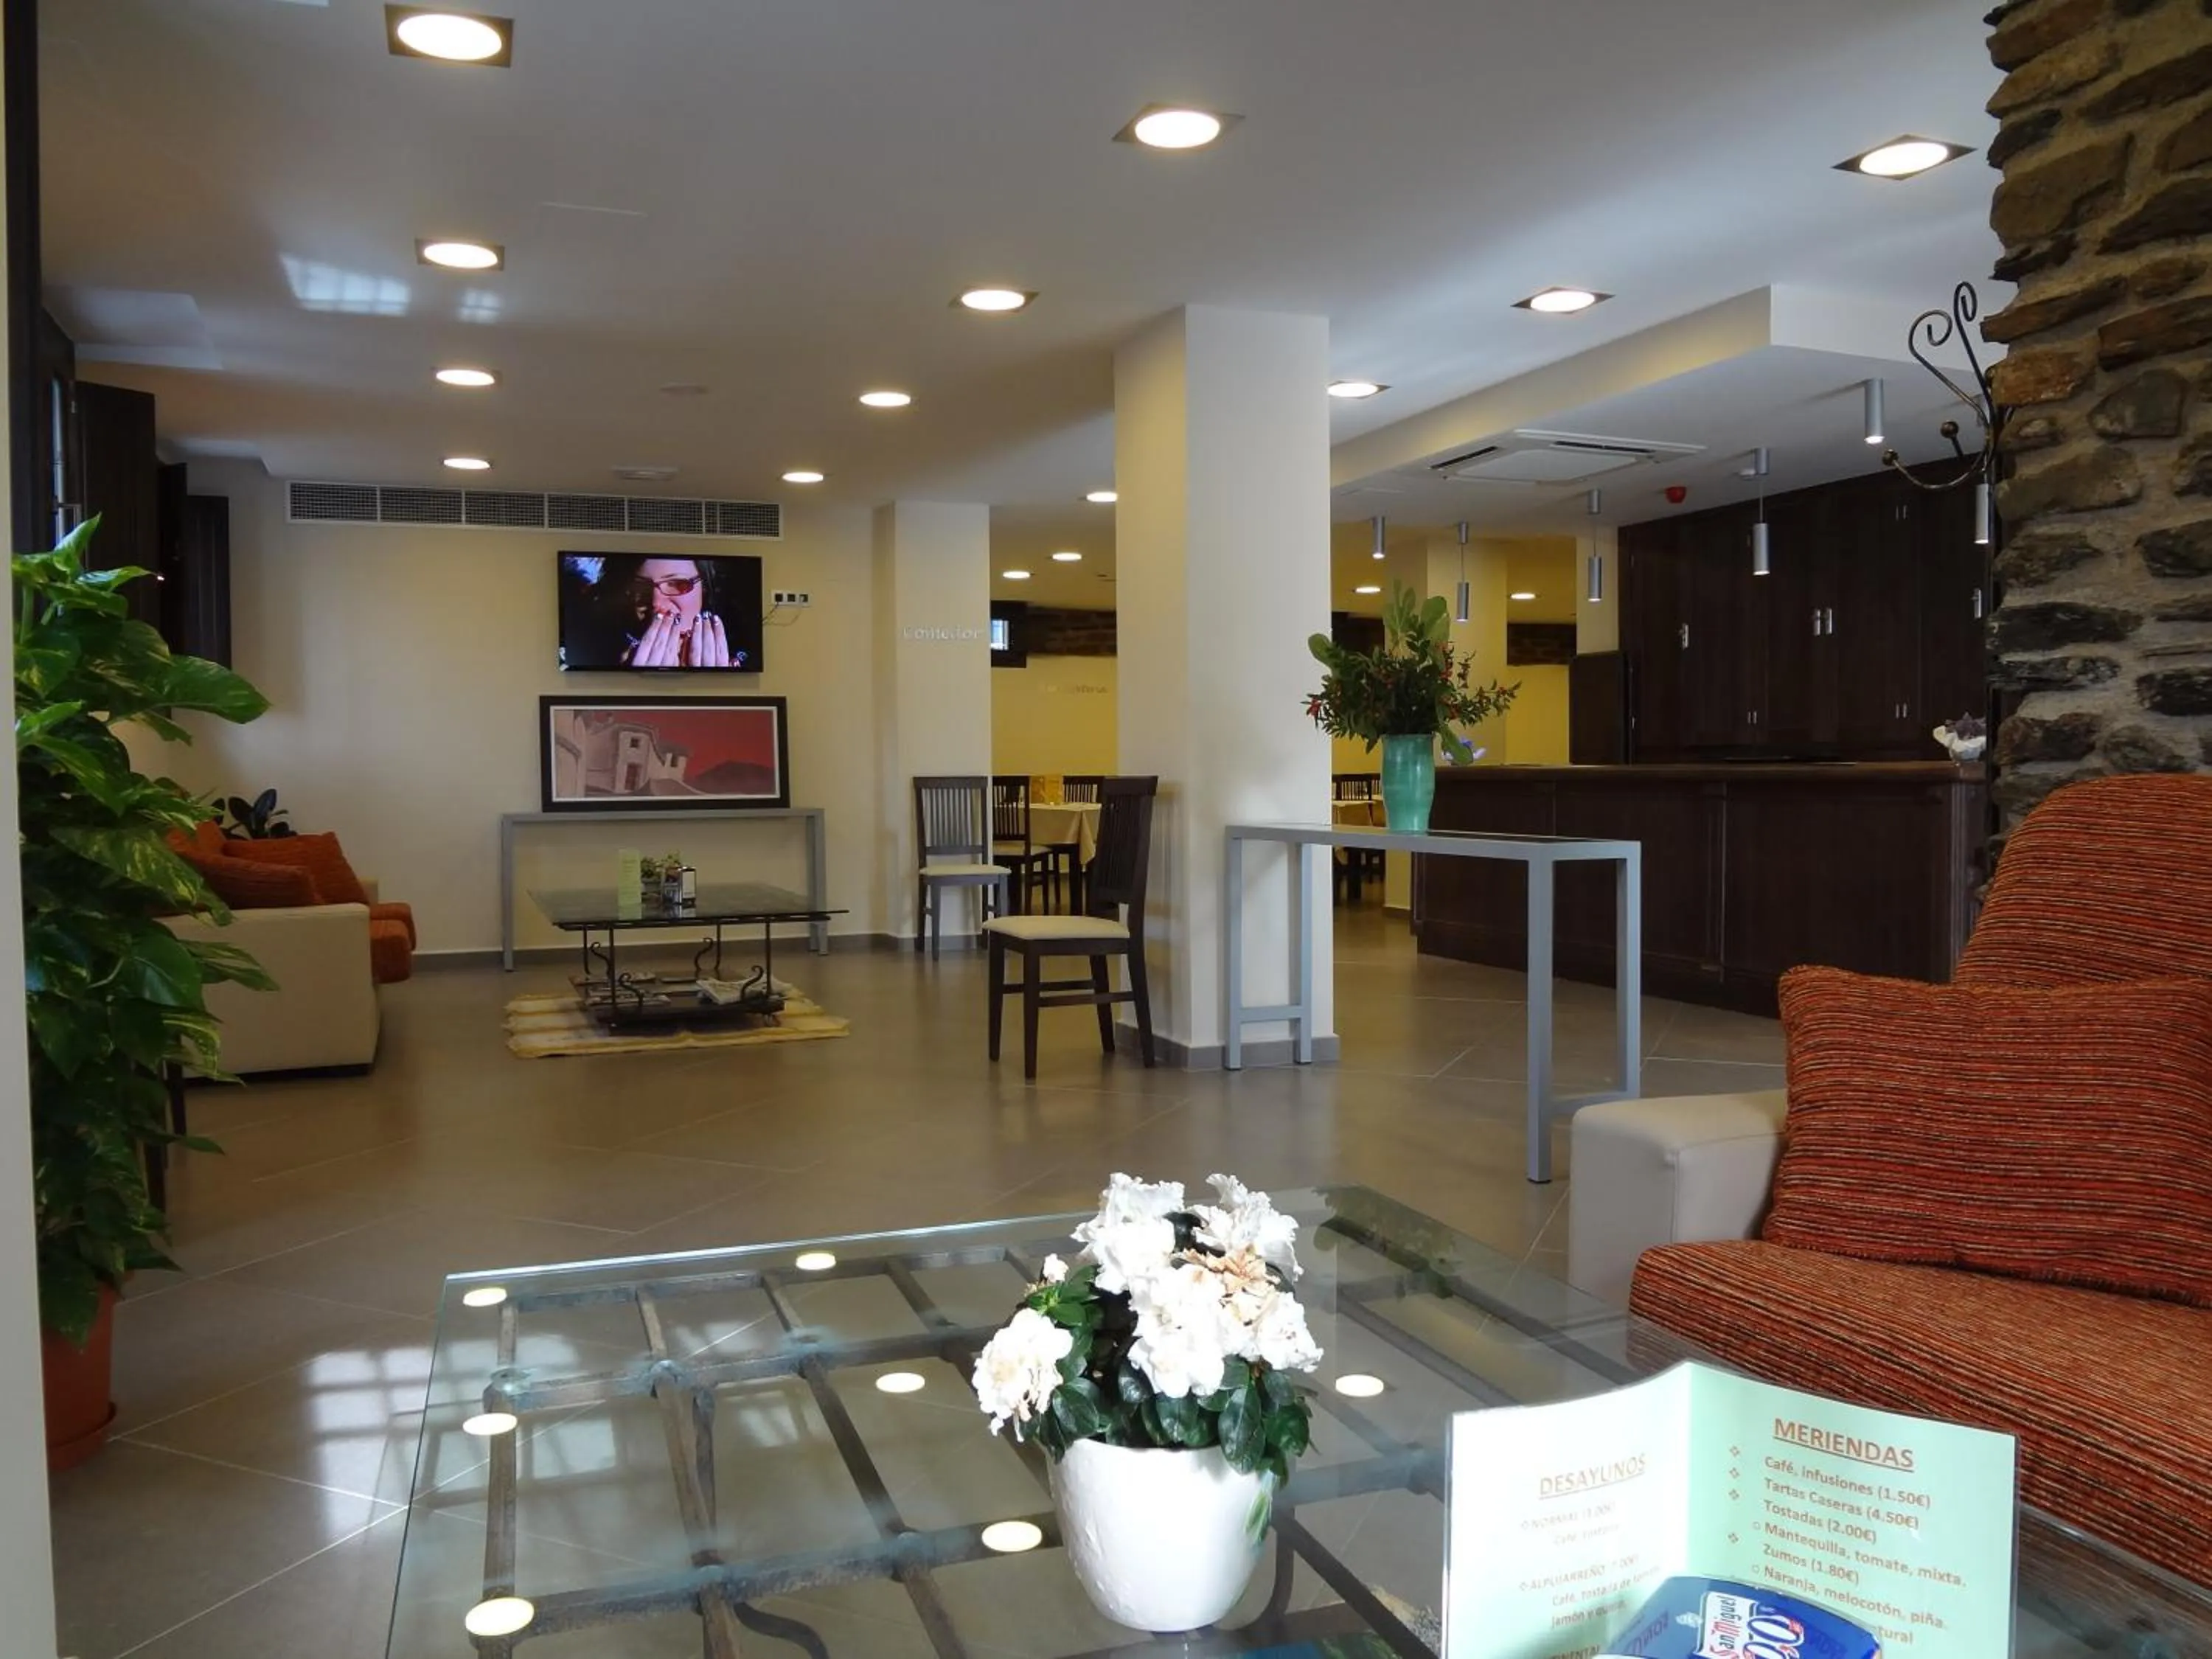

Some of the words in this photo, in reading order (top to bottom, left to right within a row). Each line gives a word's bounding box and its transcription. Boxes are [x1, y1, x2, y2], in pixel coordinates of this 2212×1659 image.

[1774, 1418, 1914, 1470] MERIENDAS
[1539, 1453, 1646, 1498] DESAYUNOS
[1802, 1466, 1874, 1496] infusiones
[1878, 1485, 1931, 1509] (1.50€)
[1764, 1477, 1806, 1500] Tartas
[1809, 1491, 1863, 1516] Caseras
[1867, 1506, 1919, 1530] (4.50€)
[1764, 1499, 1823, 1527] Tostadas
[1828, 1518, 1877, 1543] (2.00€)
[1763, 1544, 1806, 1567] Zumos
[1811, 1559, 1860, 1585] (1.80€)
[1765, 1523, 1850, 1559] Mantequilla,
[1855, 1551, 1913, 1576] tomate,
[1764, 1565, 1819, 1594] Naranja,
[1877, 1626, 1914, 1646] tural
